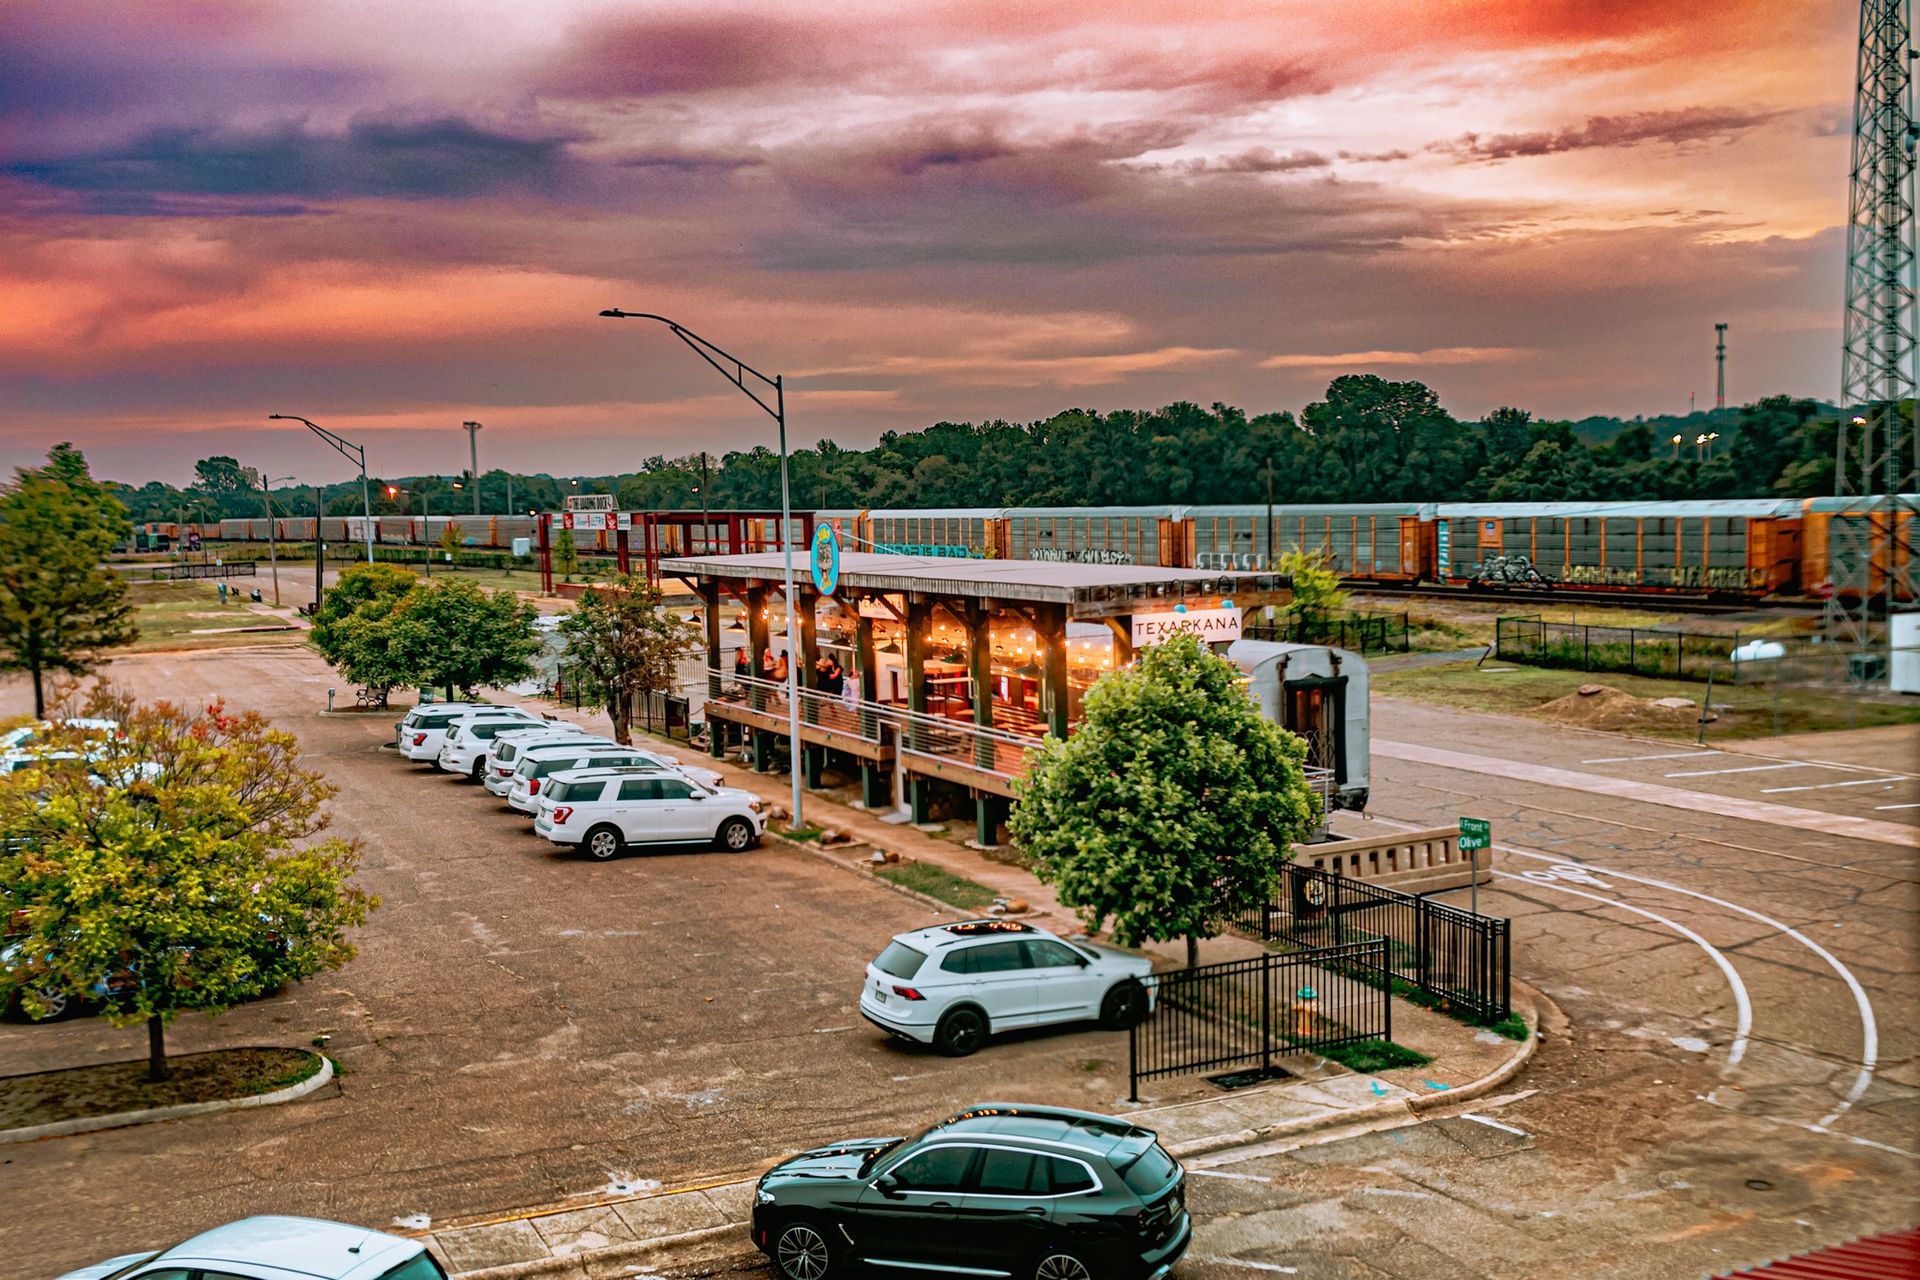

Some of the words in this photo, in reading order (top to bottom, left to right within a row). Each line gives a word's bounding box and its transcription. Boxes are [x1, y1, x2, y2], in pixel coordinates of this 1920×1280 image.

[1135, 617, 1239, 635] TEXARKANA
[1464, 820, 1482, 832] Front
[1459, 837, 1482, 848] Olive
